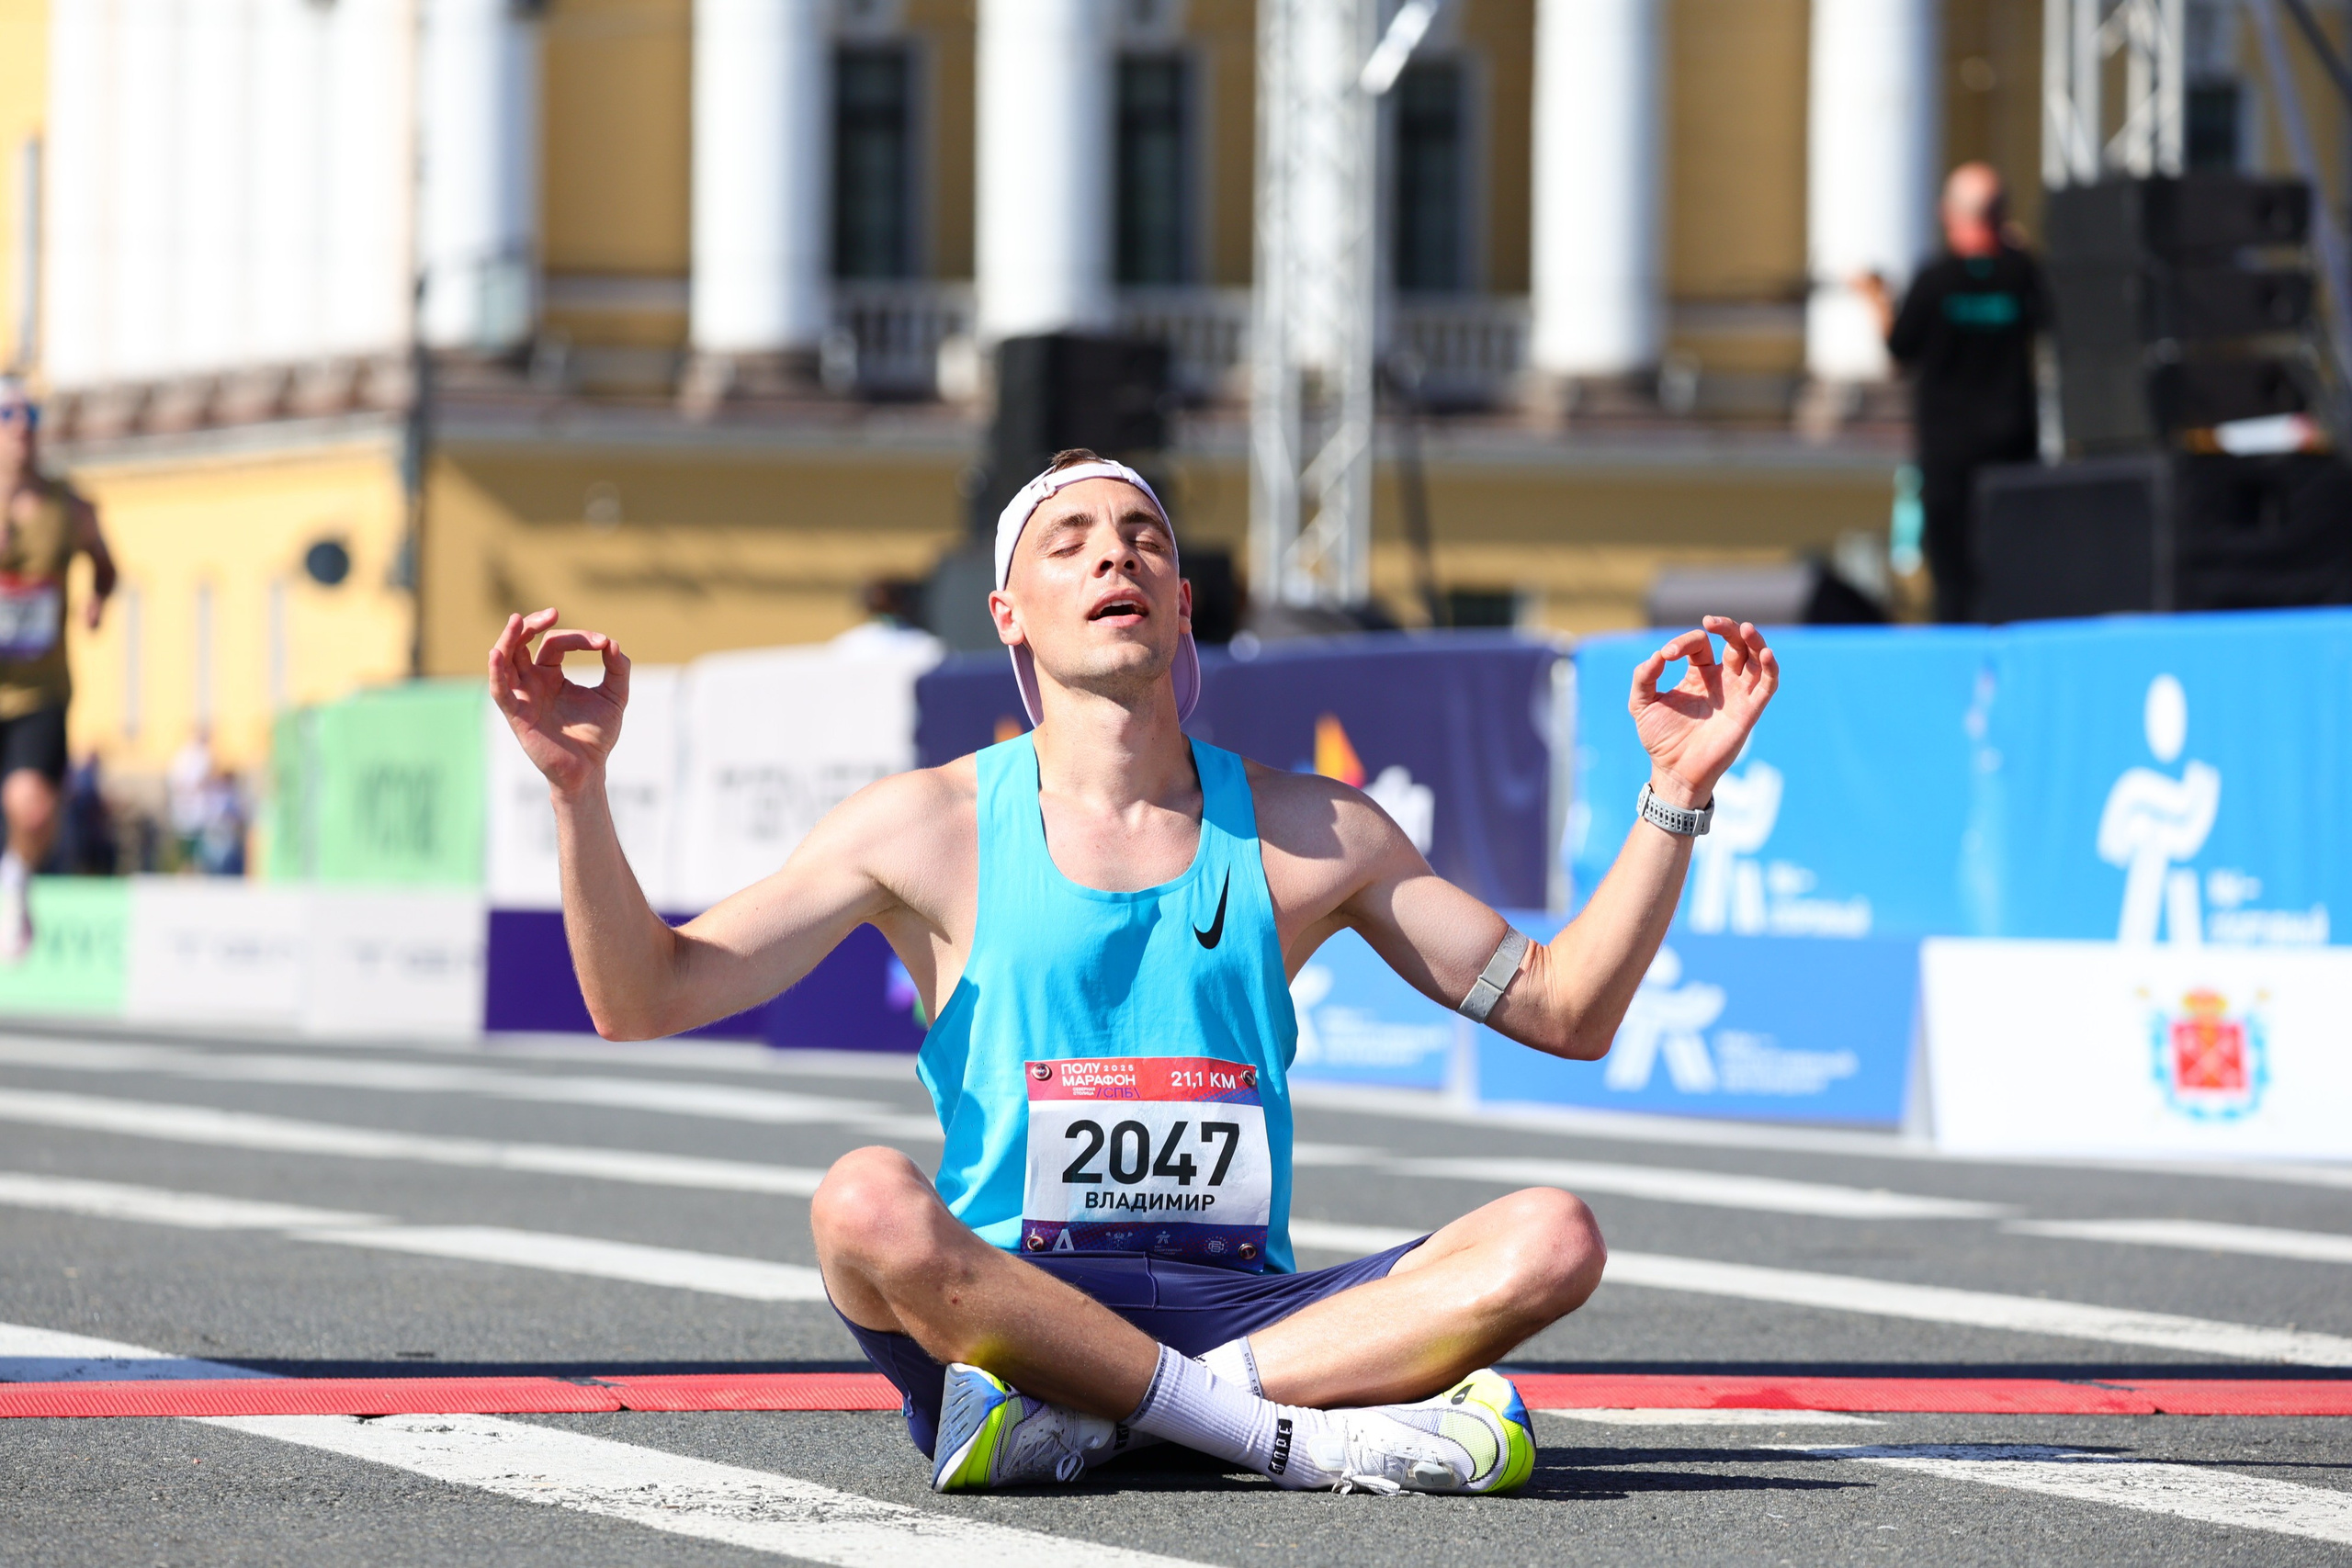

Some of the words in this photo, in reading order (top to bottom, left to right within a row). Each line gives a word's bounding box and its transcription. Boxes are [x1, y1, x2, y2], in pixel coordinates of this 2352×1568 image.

[1061, 1063, 1101, 1075] ПОЛУ
[1062, 1074, 1136, 1087] МАРАФОН
[1170, 1071, 1204, 1089] 21,1
[1210, 1072, 1237, 1089] КМ
[1062, 1119, 1240, 1186] 2047
[1085, 1191, 1216, 1213] ВЛАДИМИР
